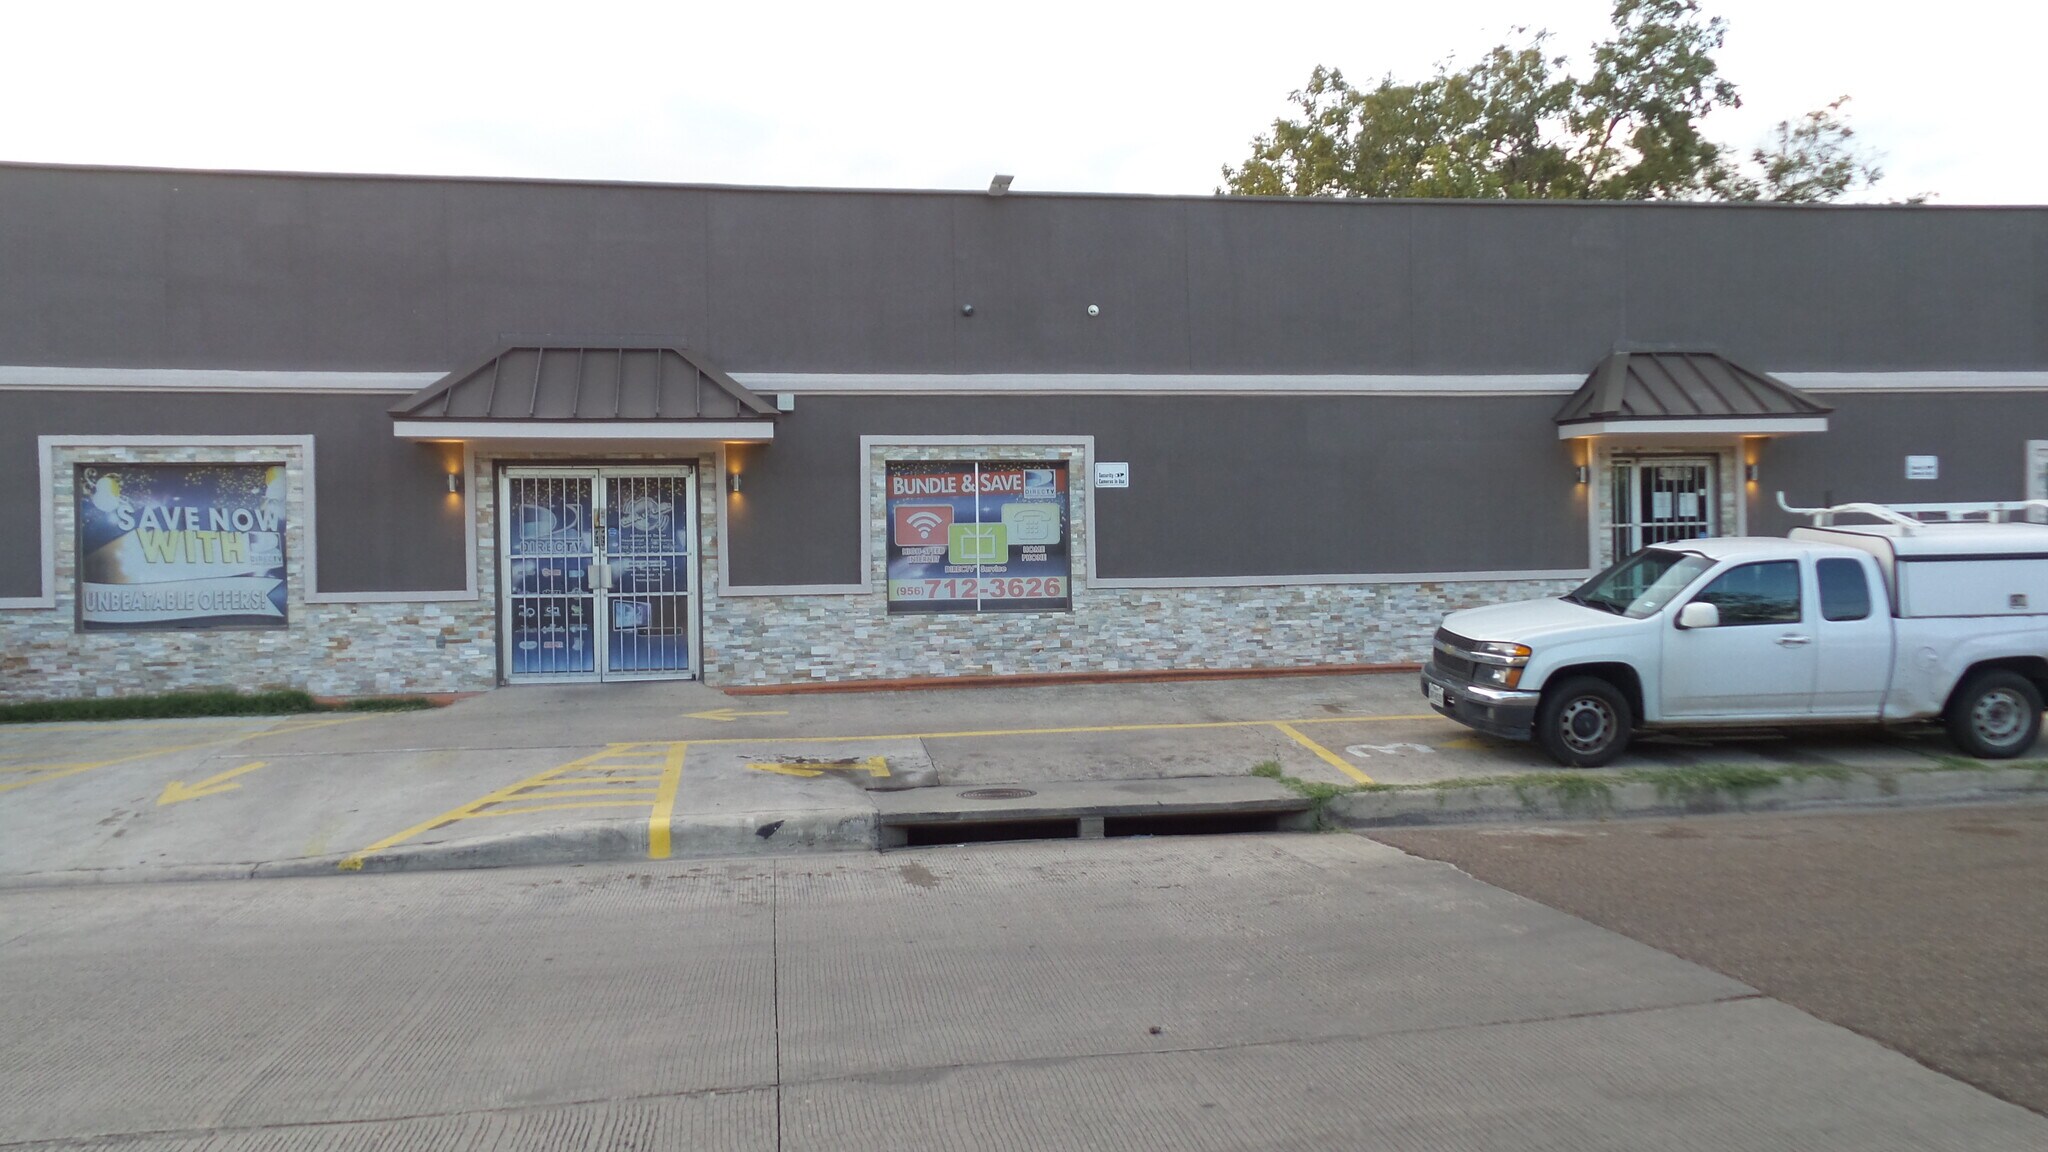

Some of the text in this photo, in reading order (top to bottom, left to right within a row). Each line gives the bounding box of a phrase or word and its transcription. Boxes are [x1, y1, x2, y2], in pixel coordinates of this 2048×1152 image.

[893, 473, 1022, 495] BUNDLE & SAVE
[116, 503, 279, 532] SAVE NOW
[135, 528, 245, 564] WITH
[519, 540, 583, 554] DIRECTV
[902, 547, 946, 555] HIGH-SPEED
[1023, 545, 1046, 554] HOME
[908, 555, 940, 564] INTERNET
[1021, 553, 1047, 562] PHONE
[980, 565, 1007, 573] Service
[896, 577, 1061, 598] (956) 712-3626
[84, 590, 267, 612] UNBEATABLE OFFERS!
